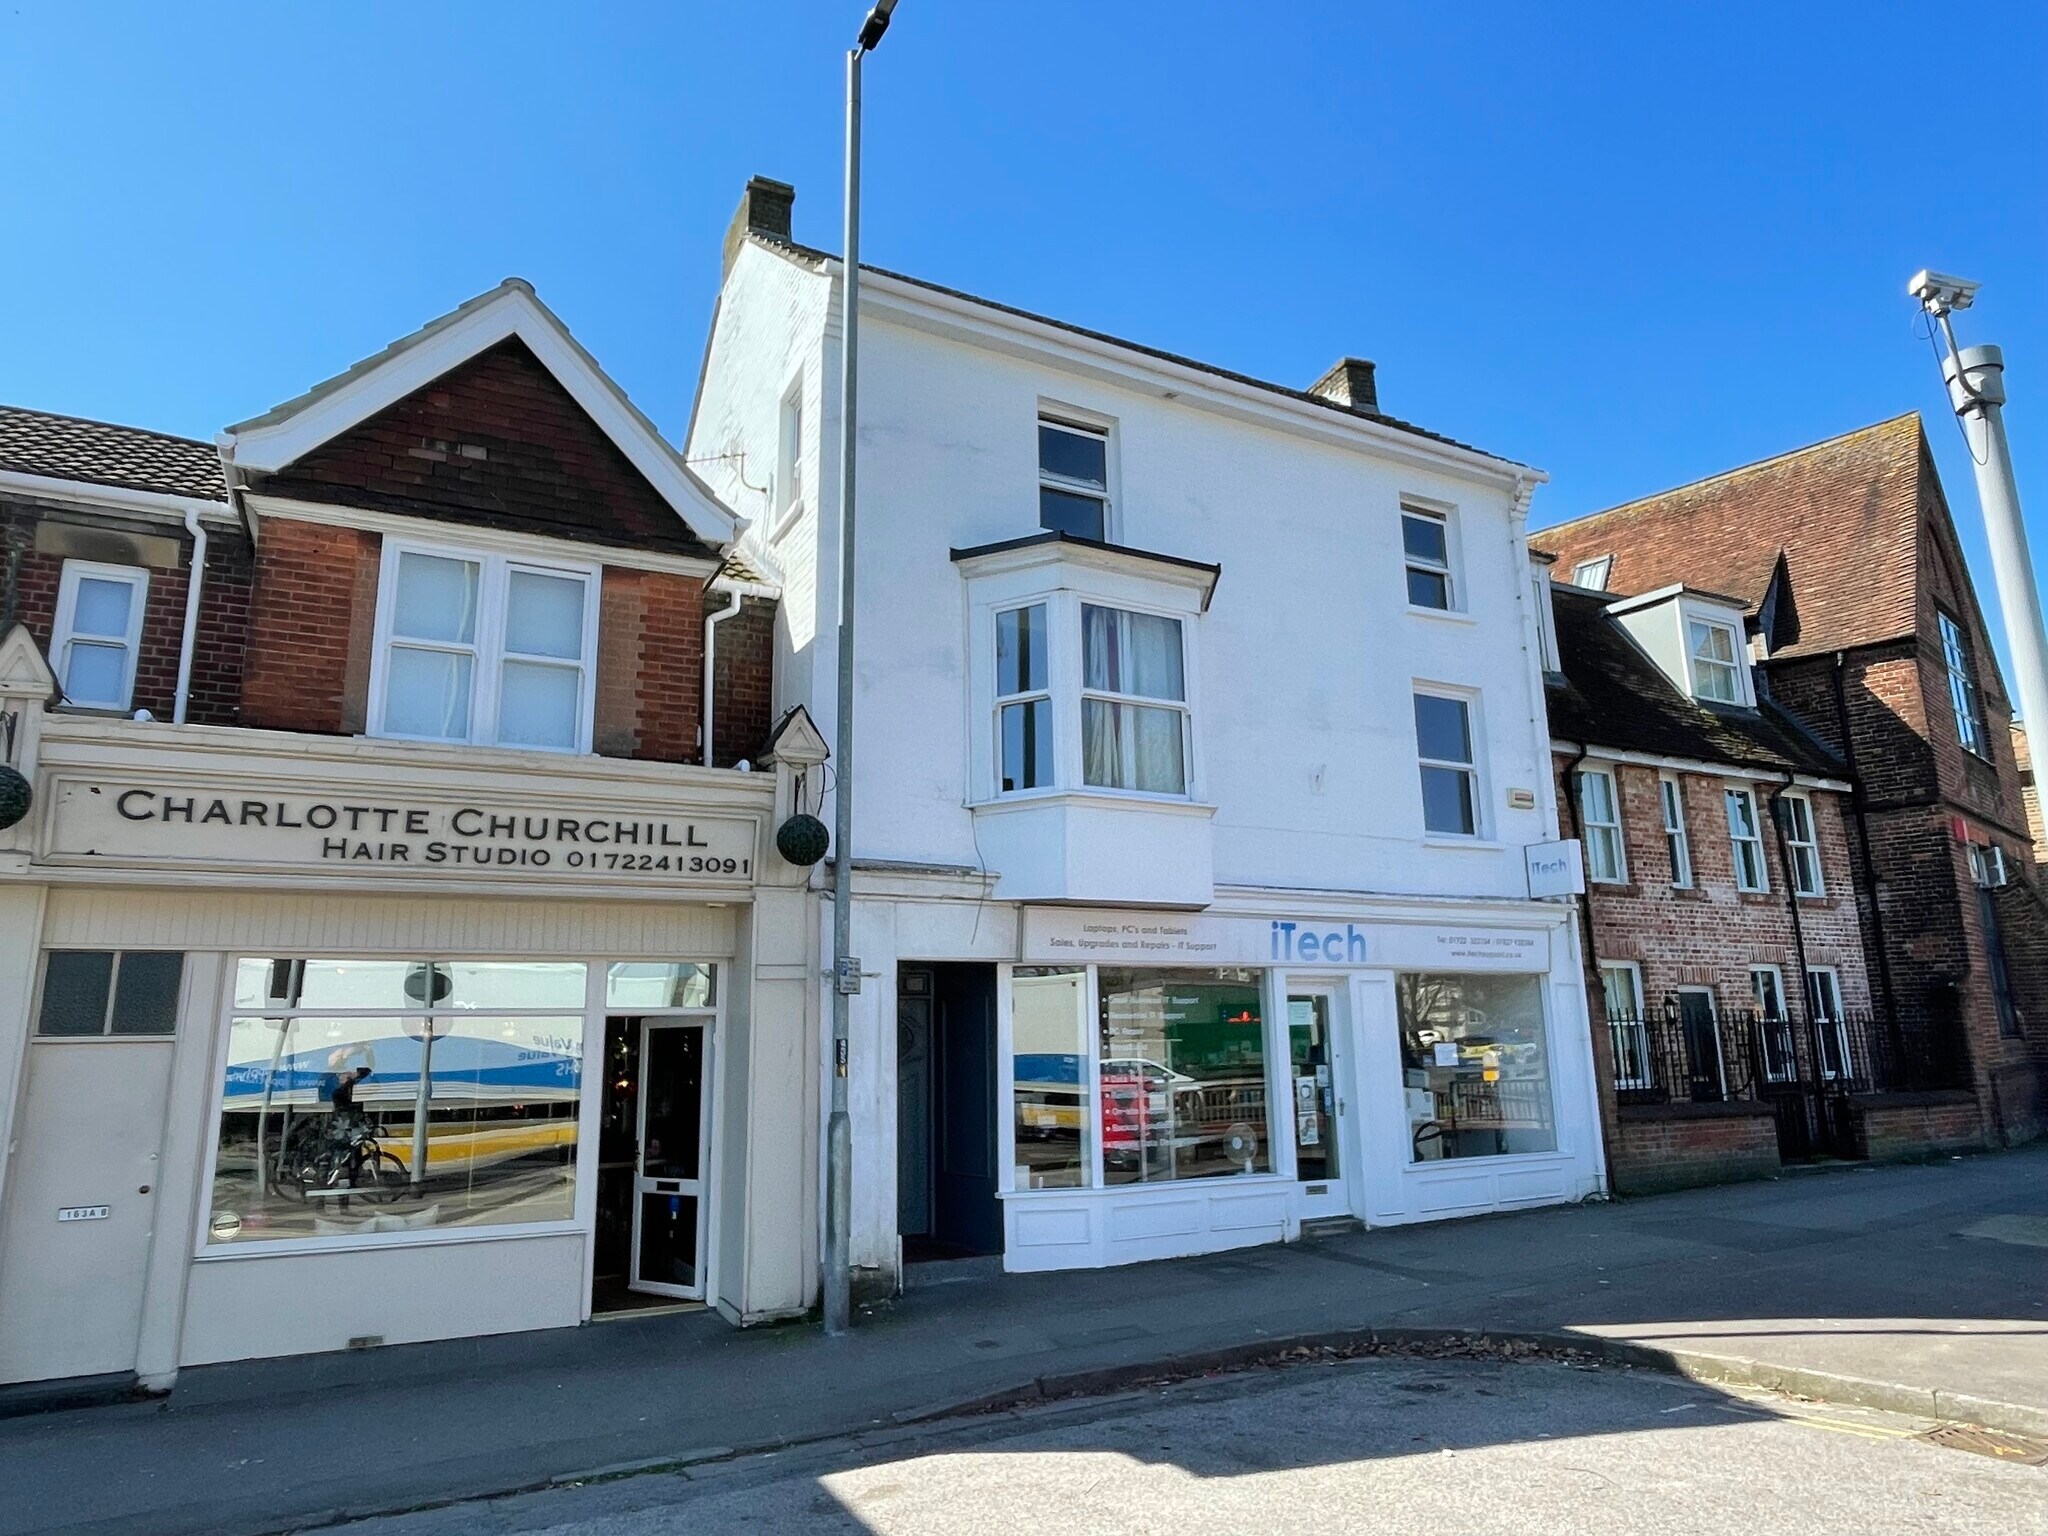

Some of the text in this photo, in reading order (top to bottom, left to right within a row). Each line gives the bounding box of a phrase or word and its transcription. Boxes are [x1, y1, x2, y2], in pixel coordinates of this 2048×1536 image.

[117, 788, 708, 848] CHARLOTTE CHURCHILL
[321, 836, 750, 876] HAIR STUDIO 01722413091
[1078, 939, 1119, 950] Upgrades
[1122, 940, 1138, 949] and
[1140, 940, 1170, 950] Repairs
[1185, 942, 1217, 952] Support
[1121, 925, 1139, 934] PC's
[1141, 926, 1157, 934] and
[1159, 926, 1187, 936] Tablets
[1271, 920, 1367, 962] iTech
